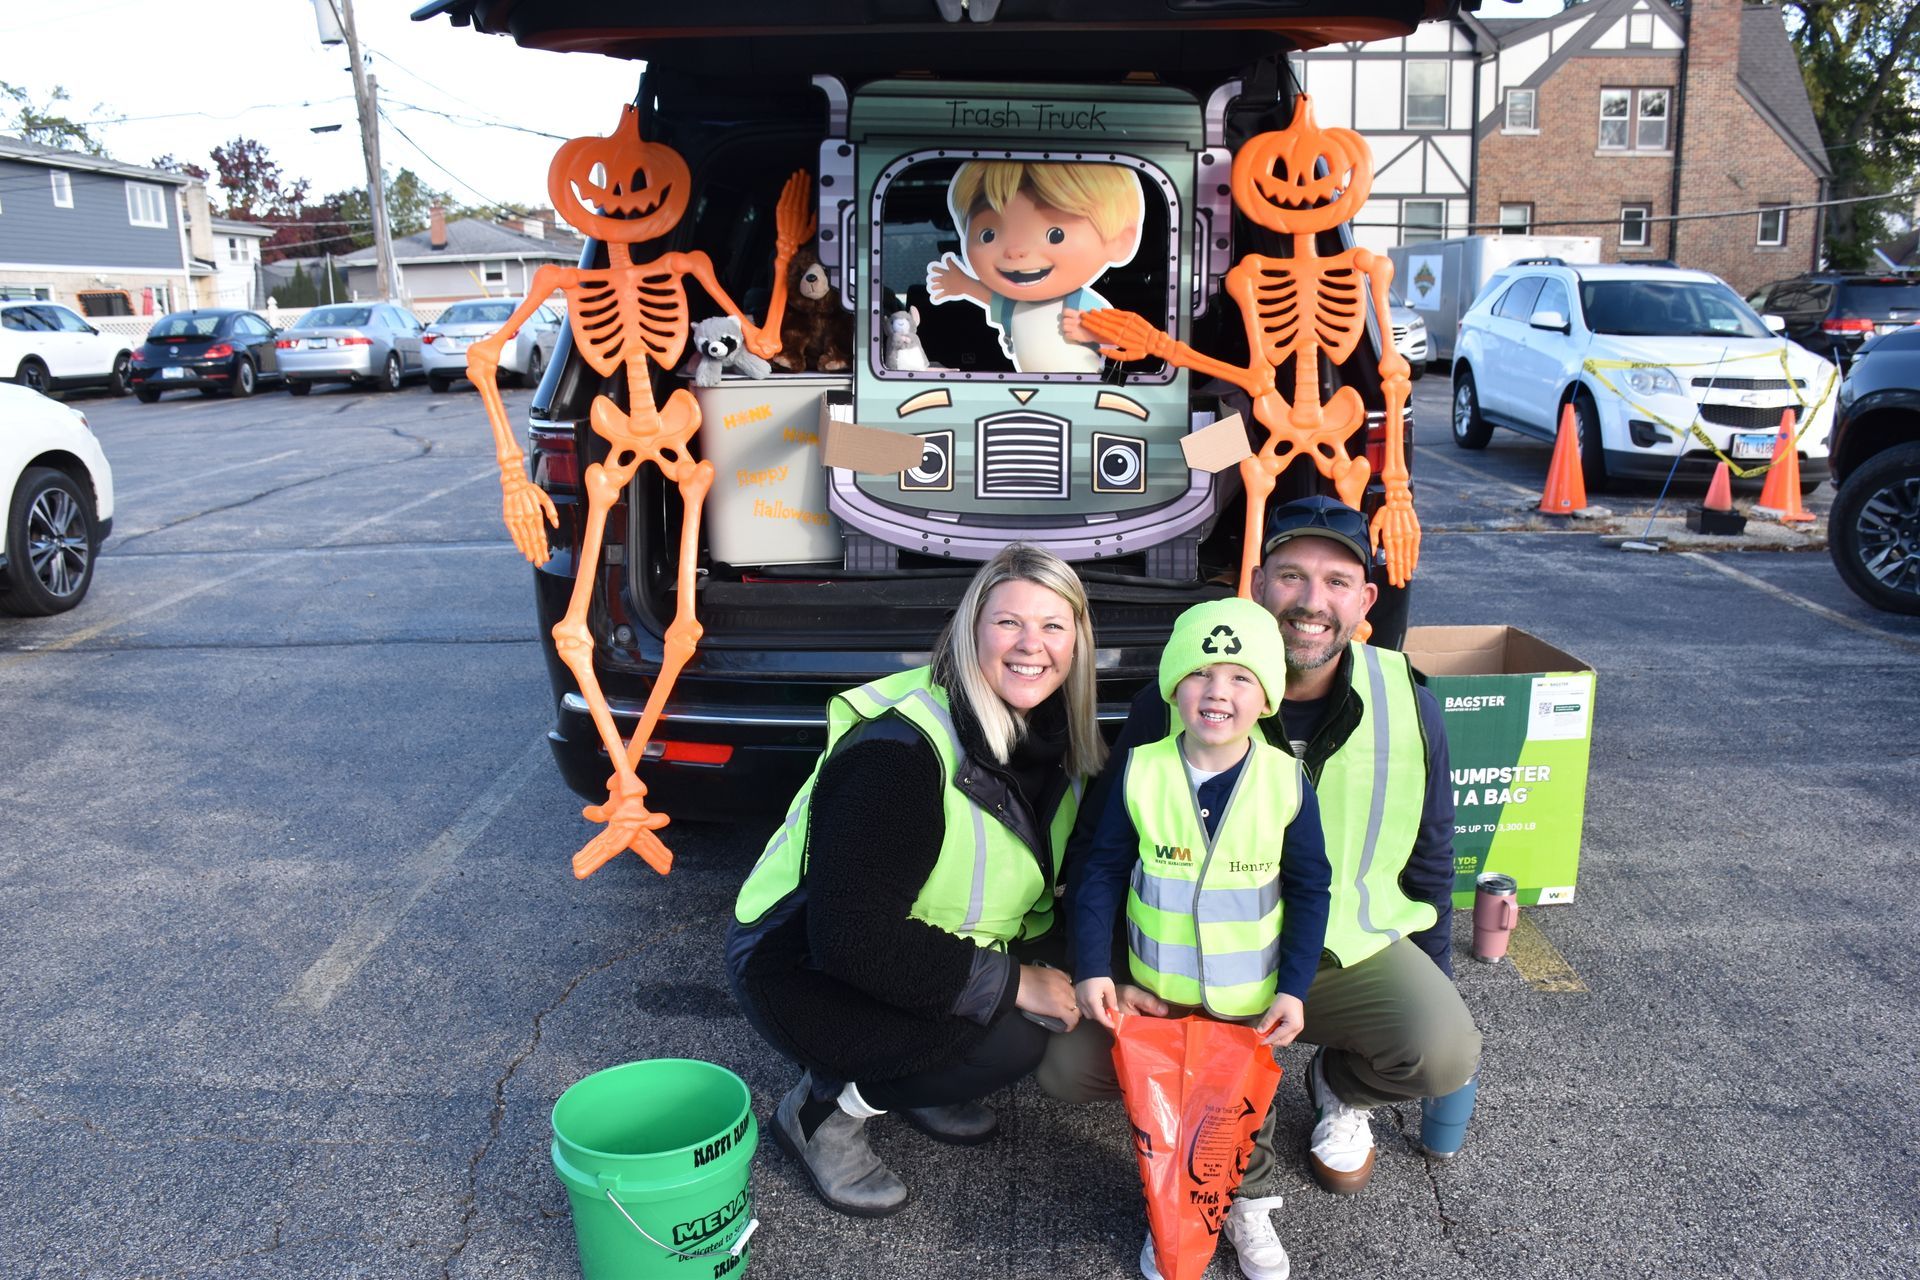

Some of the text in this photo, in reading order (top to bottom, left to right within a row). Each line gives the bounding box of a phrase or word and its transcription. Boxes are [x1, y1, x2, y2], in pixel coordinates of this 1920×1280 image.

[945, 100, 1107, 131] Trash Truck
[736, 465, 788, 487] Happy
[753, 498, 830, 526] Halloween
[1445, 695, 1506, 708] BAGSTER
[1463, 789, 1479, 806] A
[1469, 825, 1481, 833] UP
[1483, 824, 1496, 832] TO
[1498, 823, 1523, 832] 3,300
[1524, 822, 1536, 830] LB
[1155, 845, 1192, 861] WM
[1229, 861, 1273, 872] Henry
[1458, 856, 1477, 865] YDS
[694, 1133, 732, 1168] HAPPY
[1190, 1190, 1219, 1204] Trick
[1208, 1206, 1219, 1217] or
[725, 1231, 733, 1243] to
